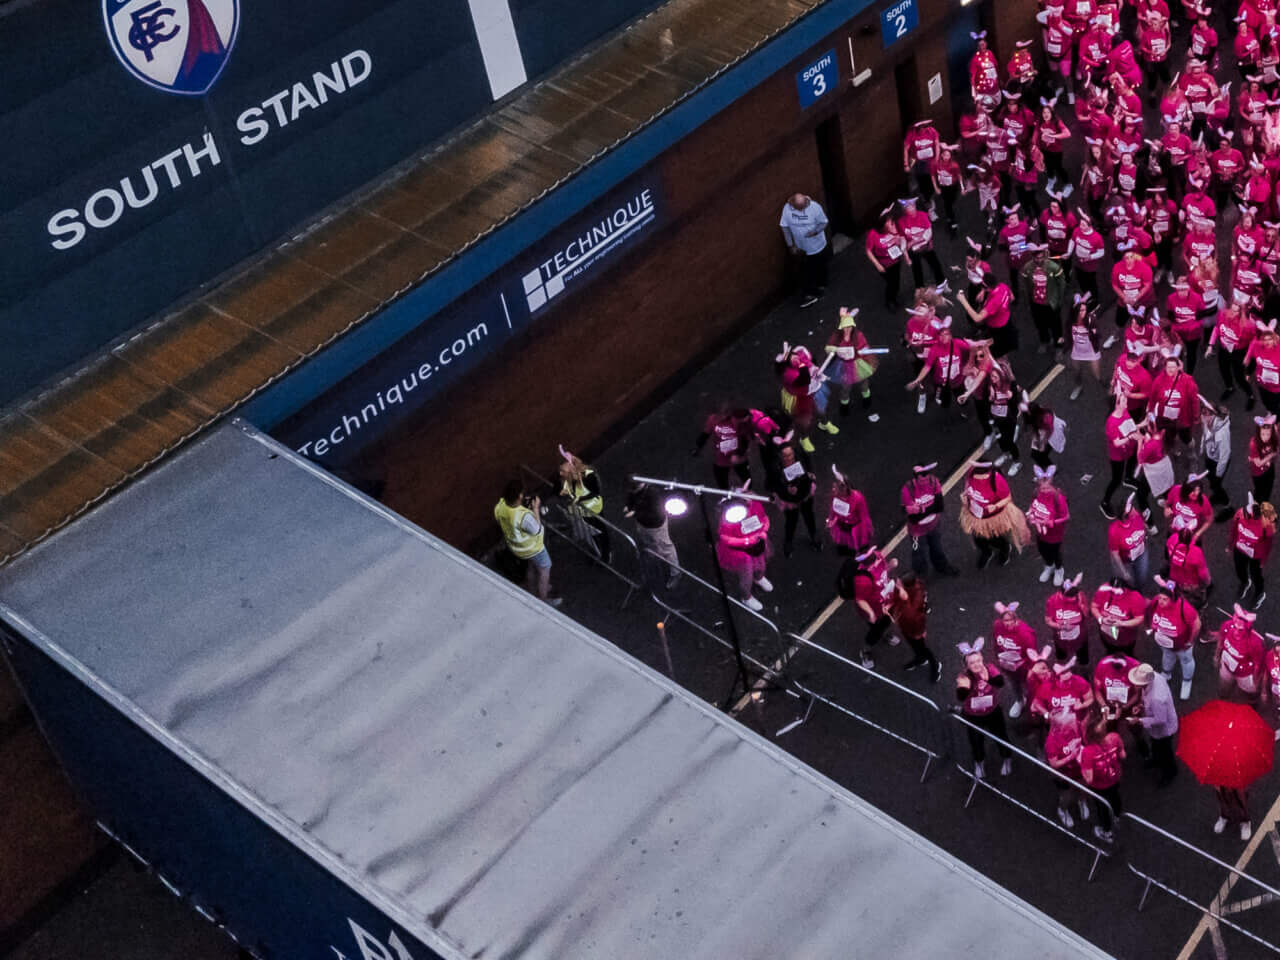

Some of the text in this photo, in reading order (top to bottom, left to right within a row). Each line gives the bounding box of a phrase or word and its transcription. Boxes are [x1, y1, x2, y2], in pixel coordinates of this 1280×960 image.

[895, 14, 908, 37] 2
[803, 55, 831, 82] SOUTH
[813, 73, 827, 96] 3
[48, 50, 373, 250] SOUTH STAND
[540, 189, 653, 279] TECHNIQUE
[297, 322, 489, 456] Technique.com
